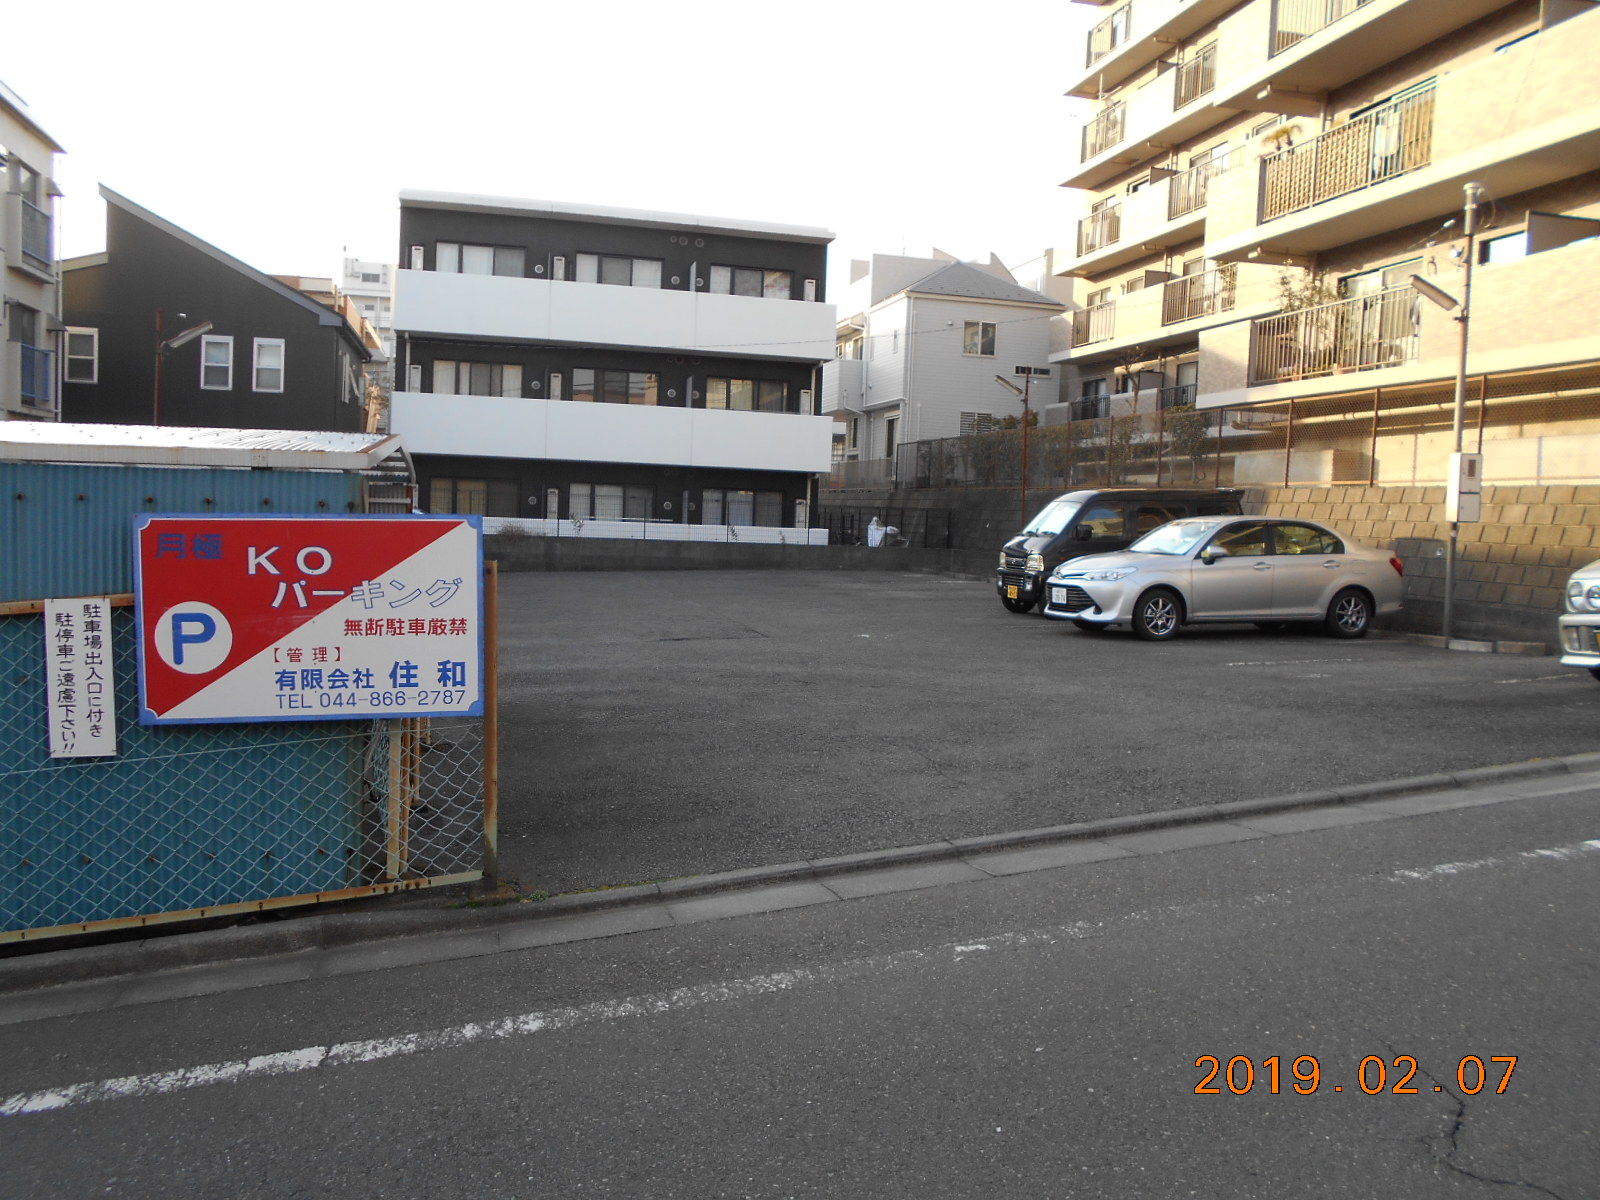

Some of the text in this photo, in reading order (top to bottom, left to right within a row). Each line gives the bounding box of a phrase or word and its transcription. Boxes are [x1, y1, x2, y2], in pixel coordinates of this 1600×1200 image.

[157, 533, 224, 560] 月極
[272, 577, 463, 609] パーキング
[172, 612, 216, 665] P
[343, 617, 468, 637] 無断駐車厳禁
[83, 604, 104, 738] 駐車場出入口に付き
[275, 659, 466, 691] 有限会社 住和
[275, 690, 466, 709] TEL 044-866-2787
